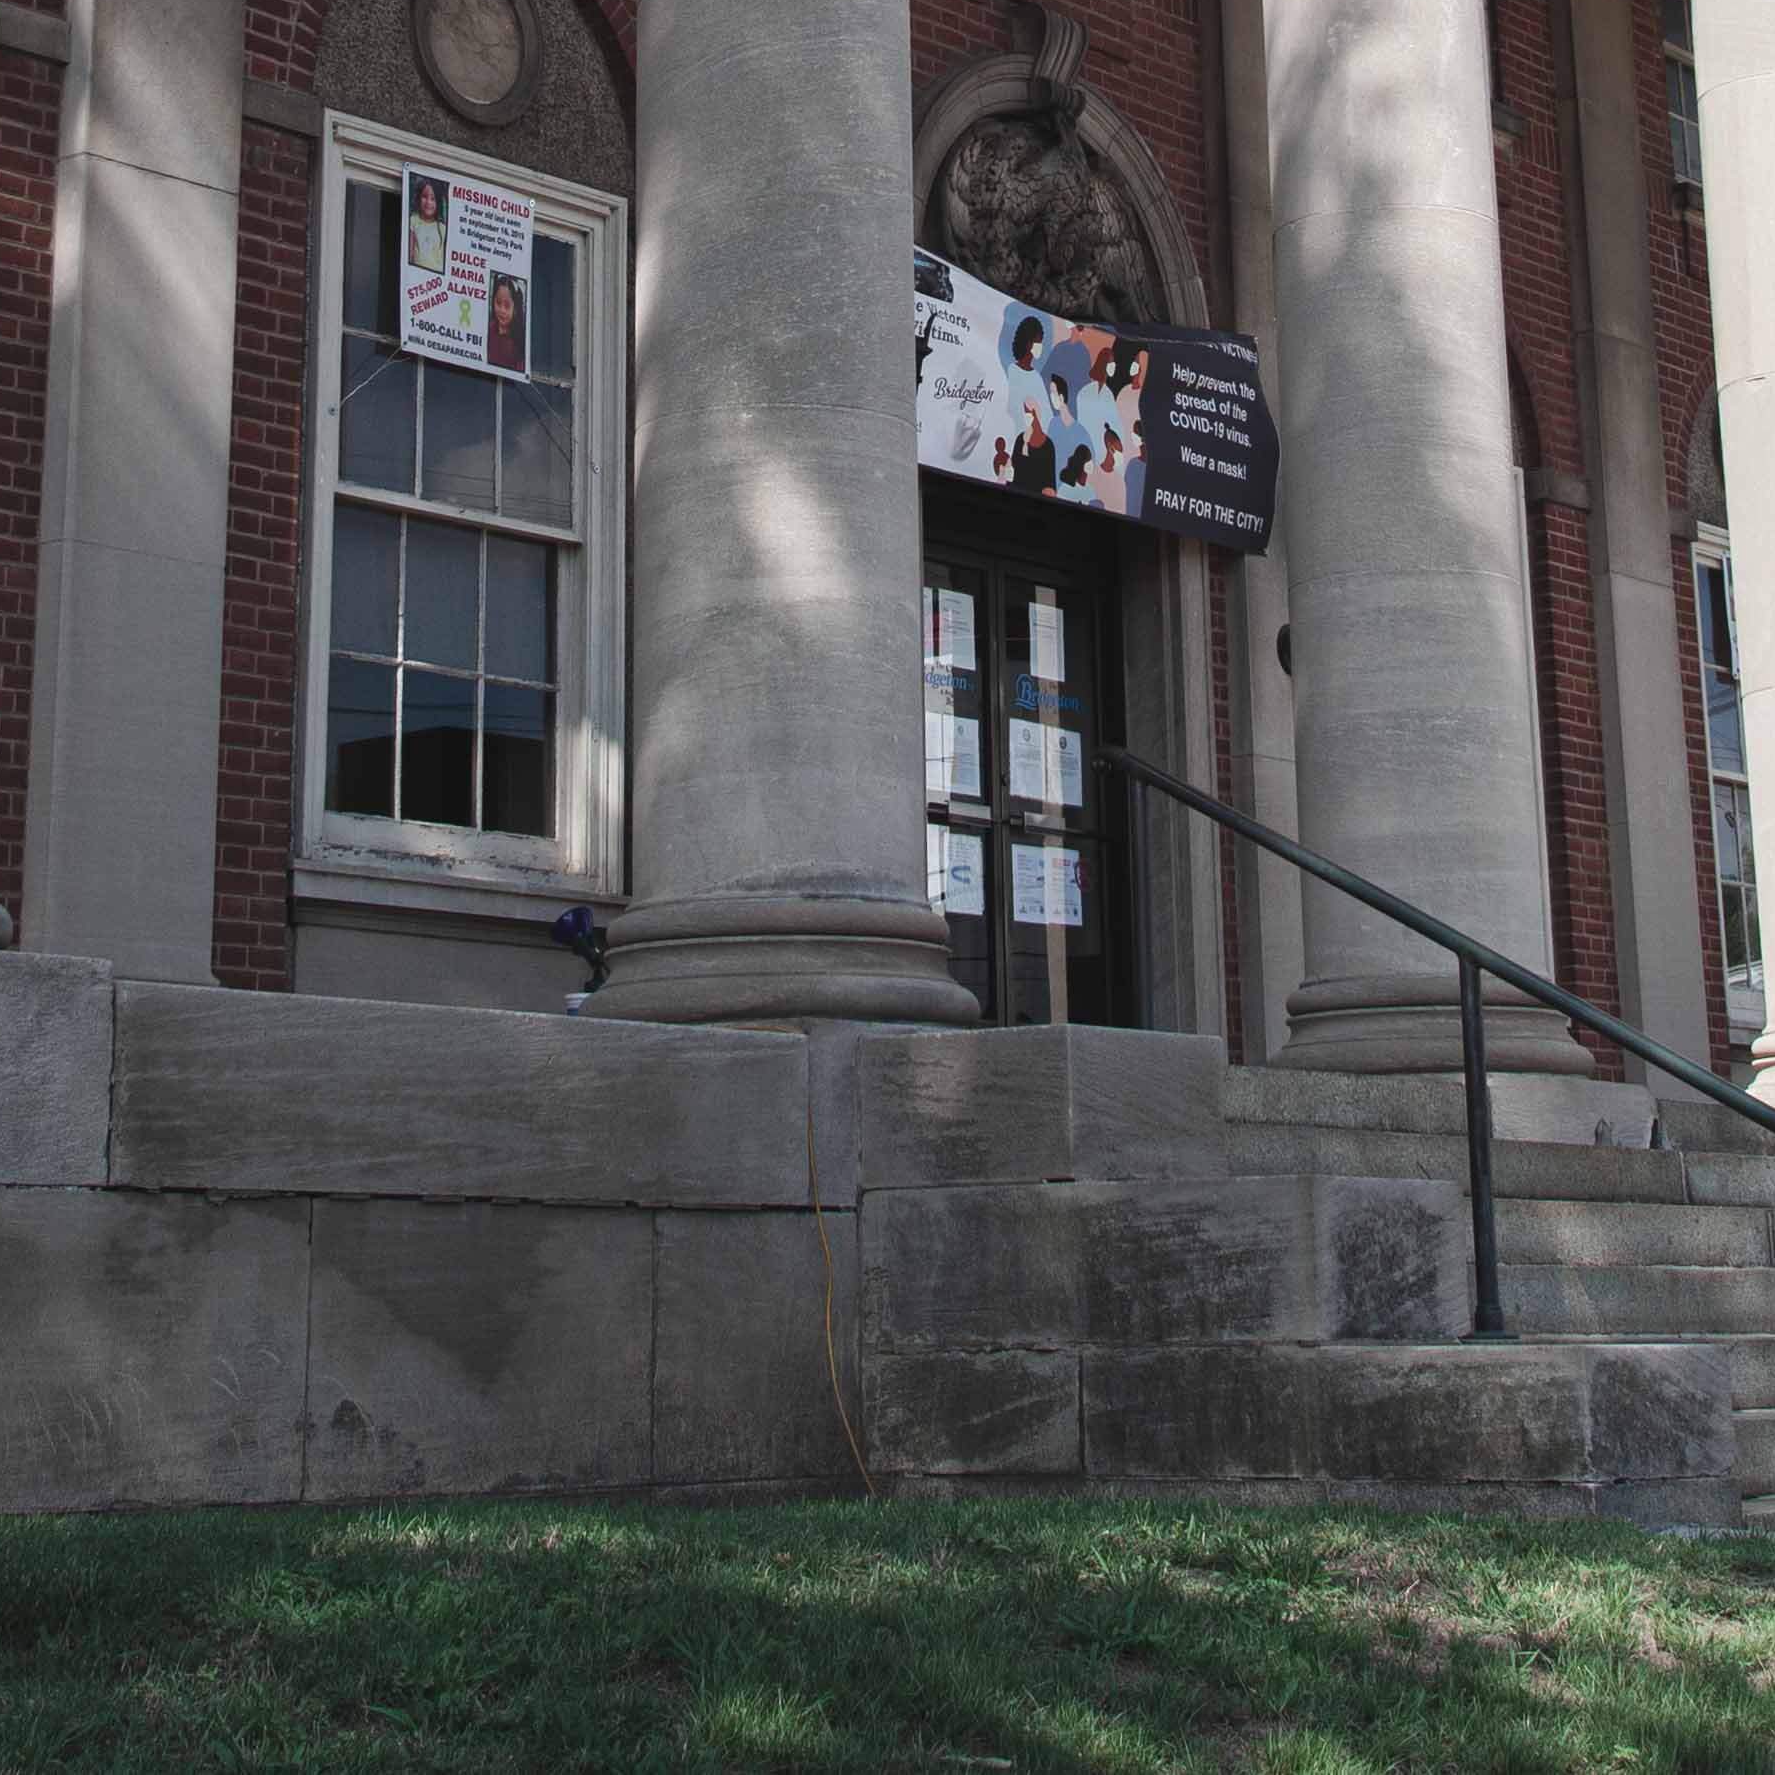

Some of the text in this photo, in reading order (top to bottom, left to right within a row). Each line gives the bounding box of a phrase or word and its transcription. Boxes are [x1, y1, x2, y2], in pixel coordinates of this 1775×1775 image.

[453, 186, 530, 218] MISSING CHILD
[470, 207, 483, 216] year
[485, 211, 493, 219] old
[467, 228, 496, 243] Bridgeton
[497, 237, 509, 248] City
[510, 241, 523, 250] Park
[451, 251, 487, 268] DULCE
[478, 242, 491, 252] New
[493, 247, 512, 261] Jersey
[450, 266, 485, 284] MARIA
[407, 277, 443, 300] $75,000
[447, 282, 487, 300] ALAVEZ
[410, 291, 449, 315] REWARD
[427, 339, 483, 362] DESAPARECIDA
[466, 333, 483, 346] FBI
[934, 377, 994, 410] Bridgeton
[1172, 363, 1256, 401] Help prevent the
[1175, 392, 1247, 422] spread of the
[1170, 411, 1252, 447] COVID-19 virus.
[1180, 445, 1246, 480] Wear a mask!
[1155, 488, 1264, 533] PRAY FOR THE CITY!
